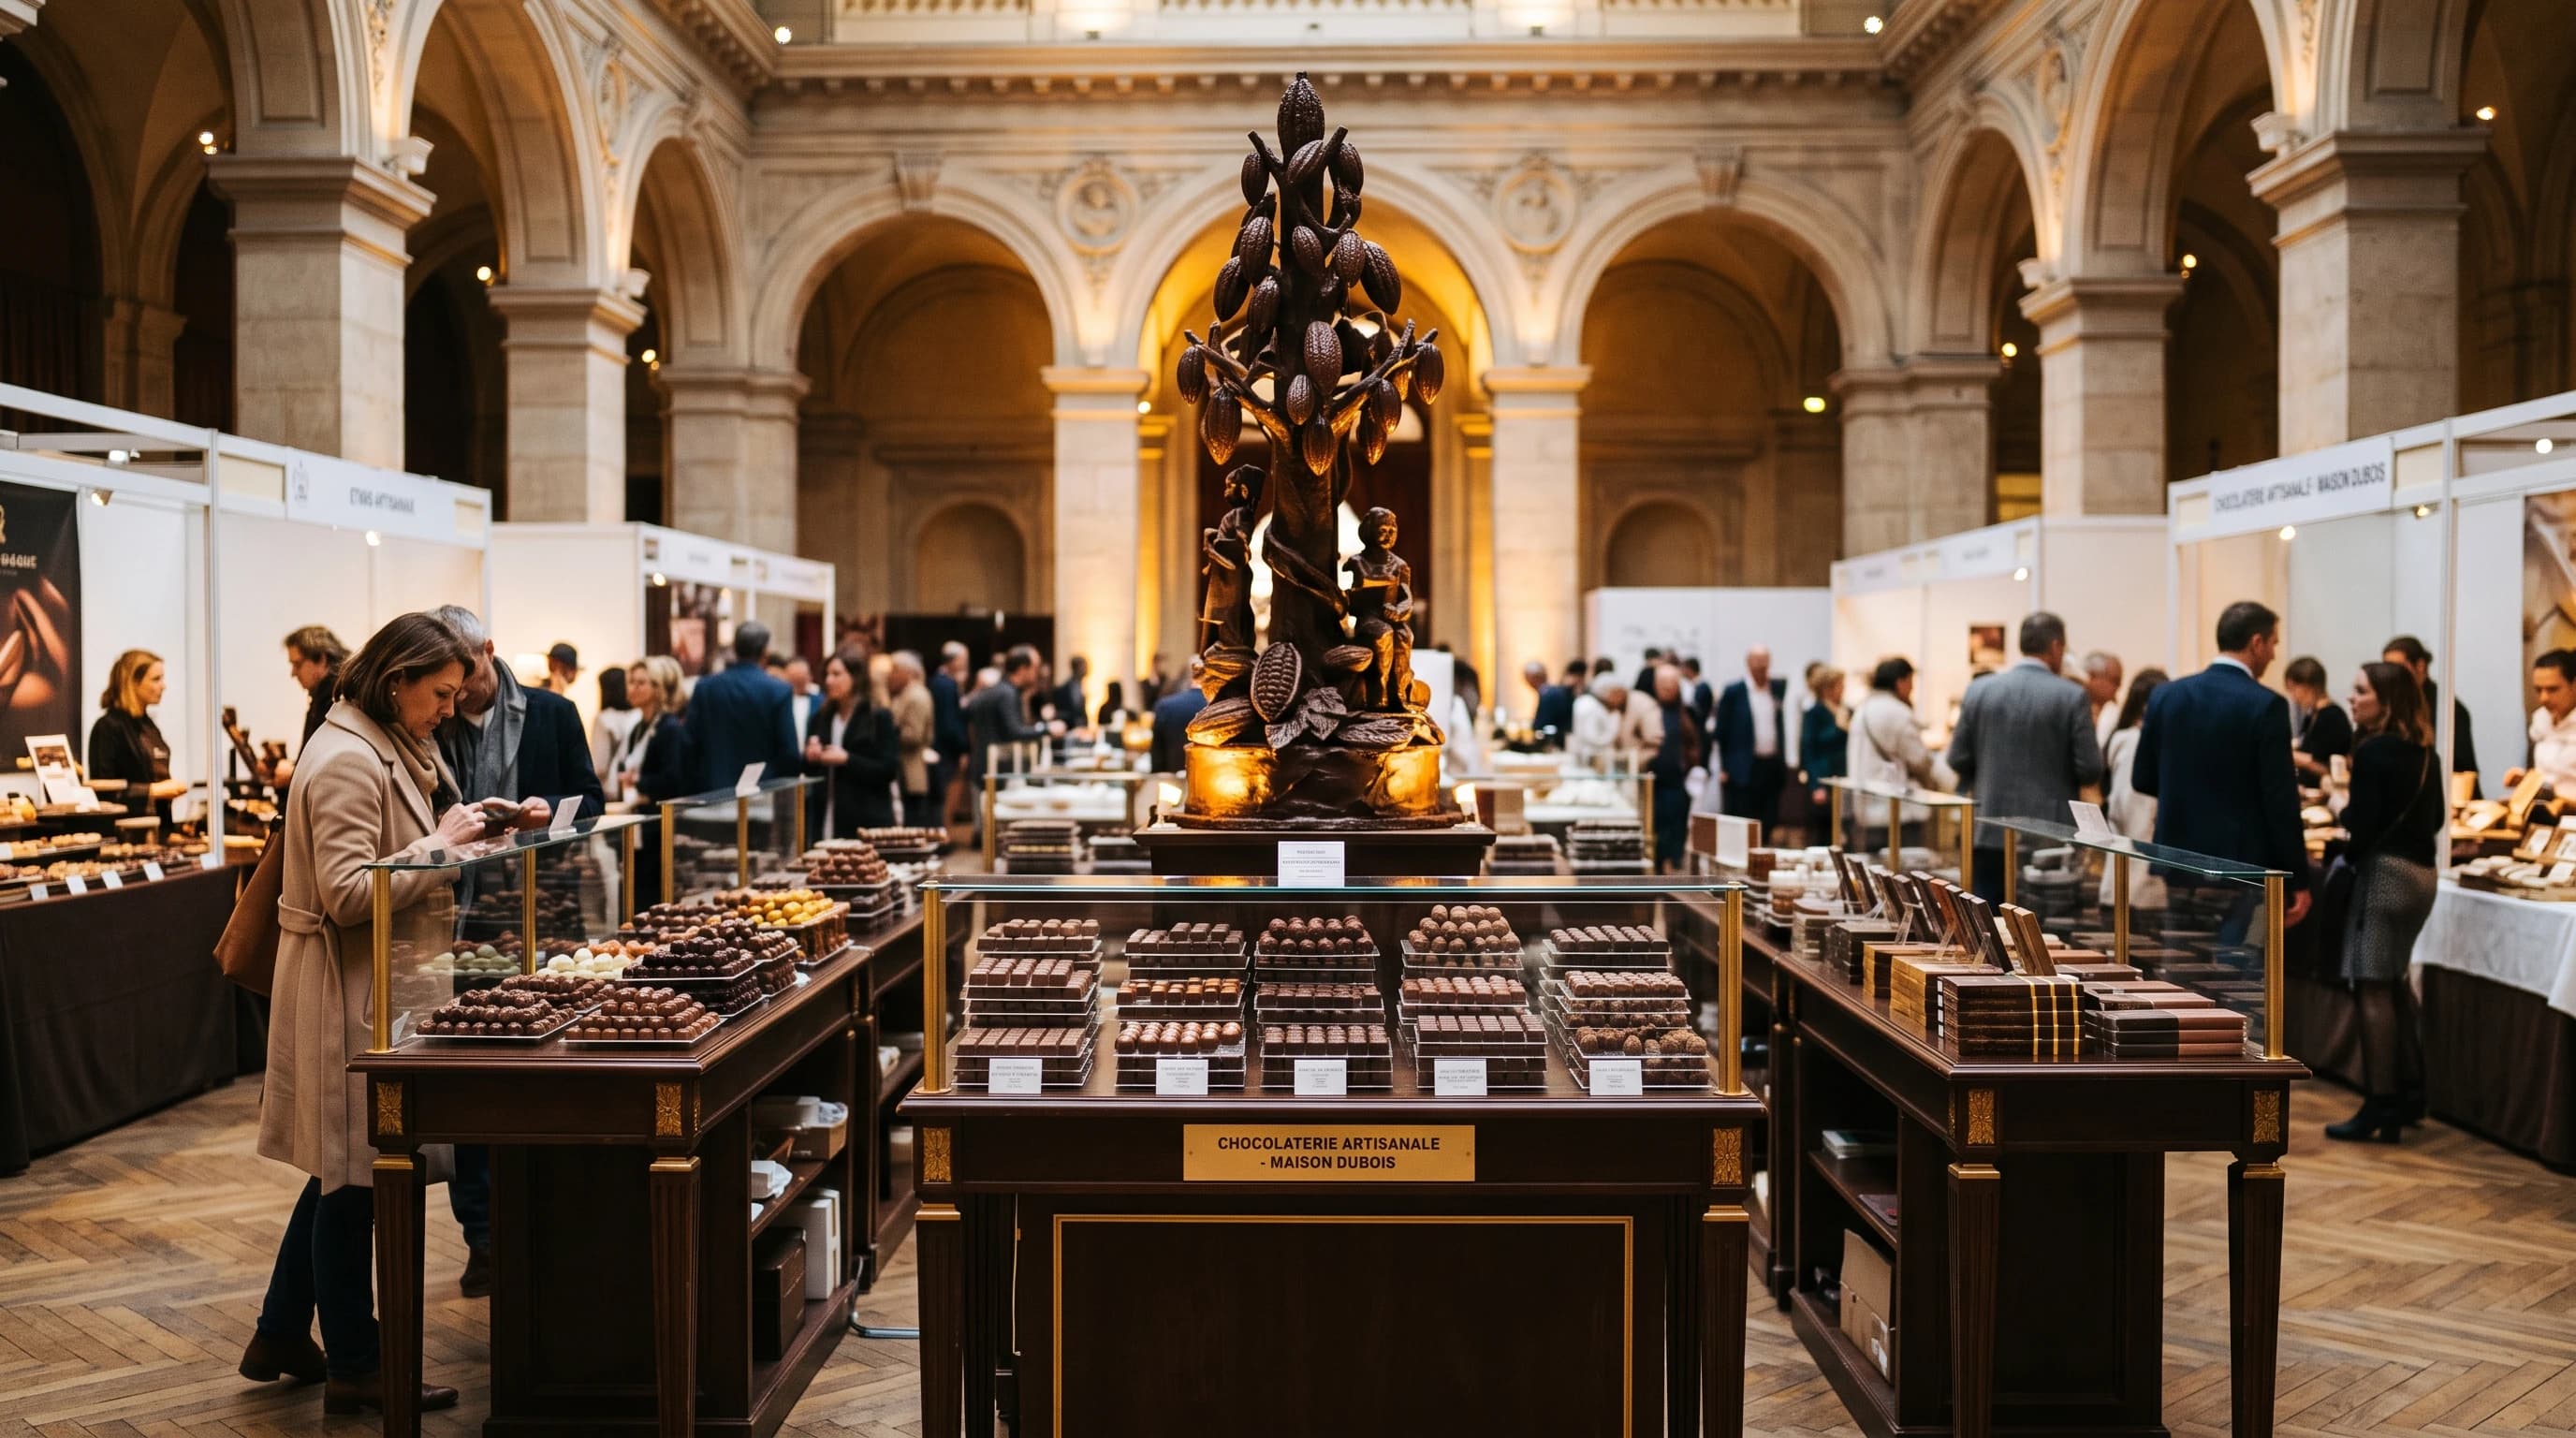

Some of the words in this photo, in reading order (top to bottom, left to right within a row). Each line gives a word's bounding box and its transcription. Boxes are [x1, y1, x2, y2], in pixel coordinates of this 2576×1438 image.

[2317, 468, 2349, 492] MAISON
[2351, 462, 2386, 487] DUBOIS
[1218, 1137, 1338, 1151] CHOCOLATERIE
[1341, 1137, 1441, 1151] ARTISANALE
[1270, 1155, 1332, 1169] MAISON
[1337, 1155, 1396, 1169] DUBOIS
